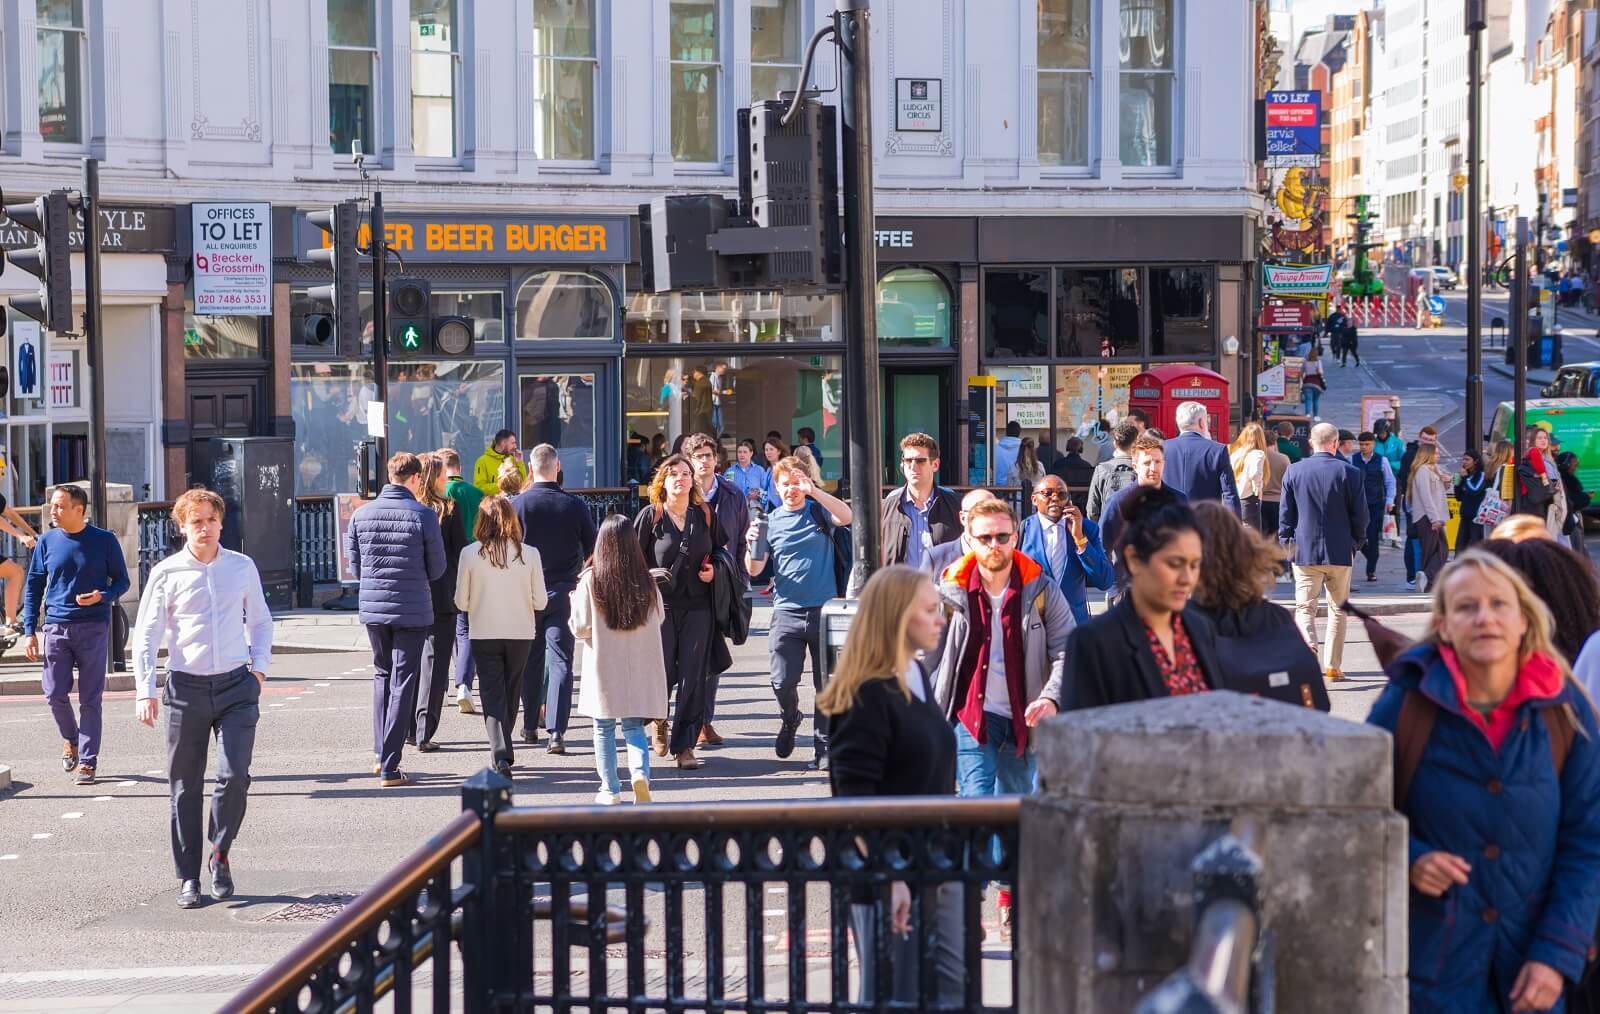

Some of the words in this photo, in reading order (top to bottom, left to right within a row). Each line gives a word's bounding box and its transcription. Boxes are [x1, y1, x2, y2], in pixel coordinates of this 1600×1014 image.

[1272, 94, 1288, 103] TO
[1290, 94, 1310, 103] LET
[903, 103, 936, 111] LUDGATE
[907, 111, 931, 119] CIRCUS
[1267, 128, 1294, 138] arvis
[207, 208, 255, 219] OFFICES
[76, 210, 146, 231] SYLE
[200, 223, 226, 240] TO
[233, 223, 263, 240] LET
[322, 223, 414, 251] NER
[426, 223, 494, 251] BEER
[506, 224, 606, 251] BURGER
[212, 253, 253, 263] Brecker
[212, 264, 265, 273] Grossmith
[1273, 272, 1299, 282] Krispy
[1299, 271, 1325, 281] Kreme
[198, 295, 215, 304] 020
[218, 295, 241, 304] 7486
[244, 295, 266, 304] 3531
[1175, 388, 1218, 398] TELEPHONE
